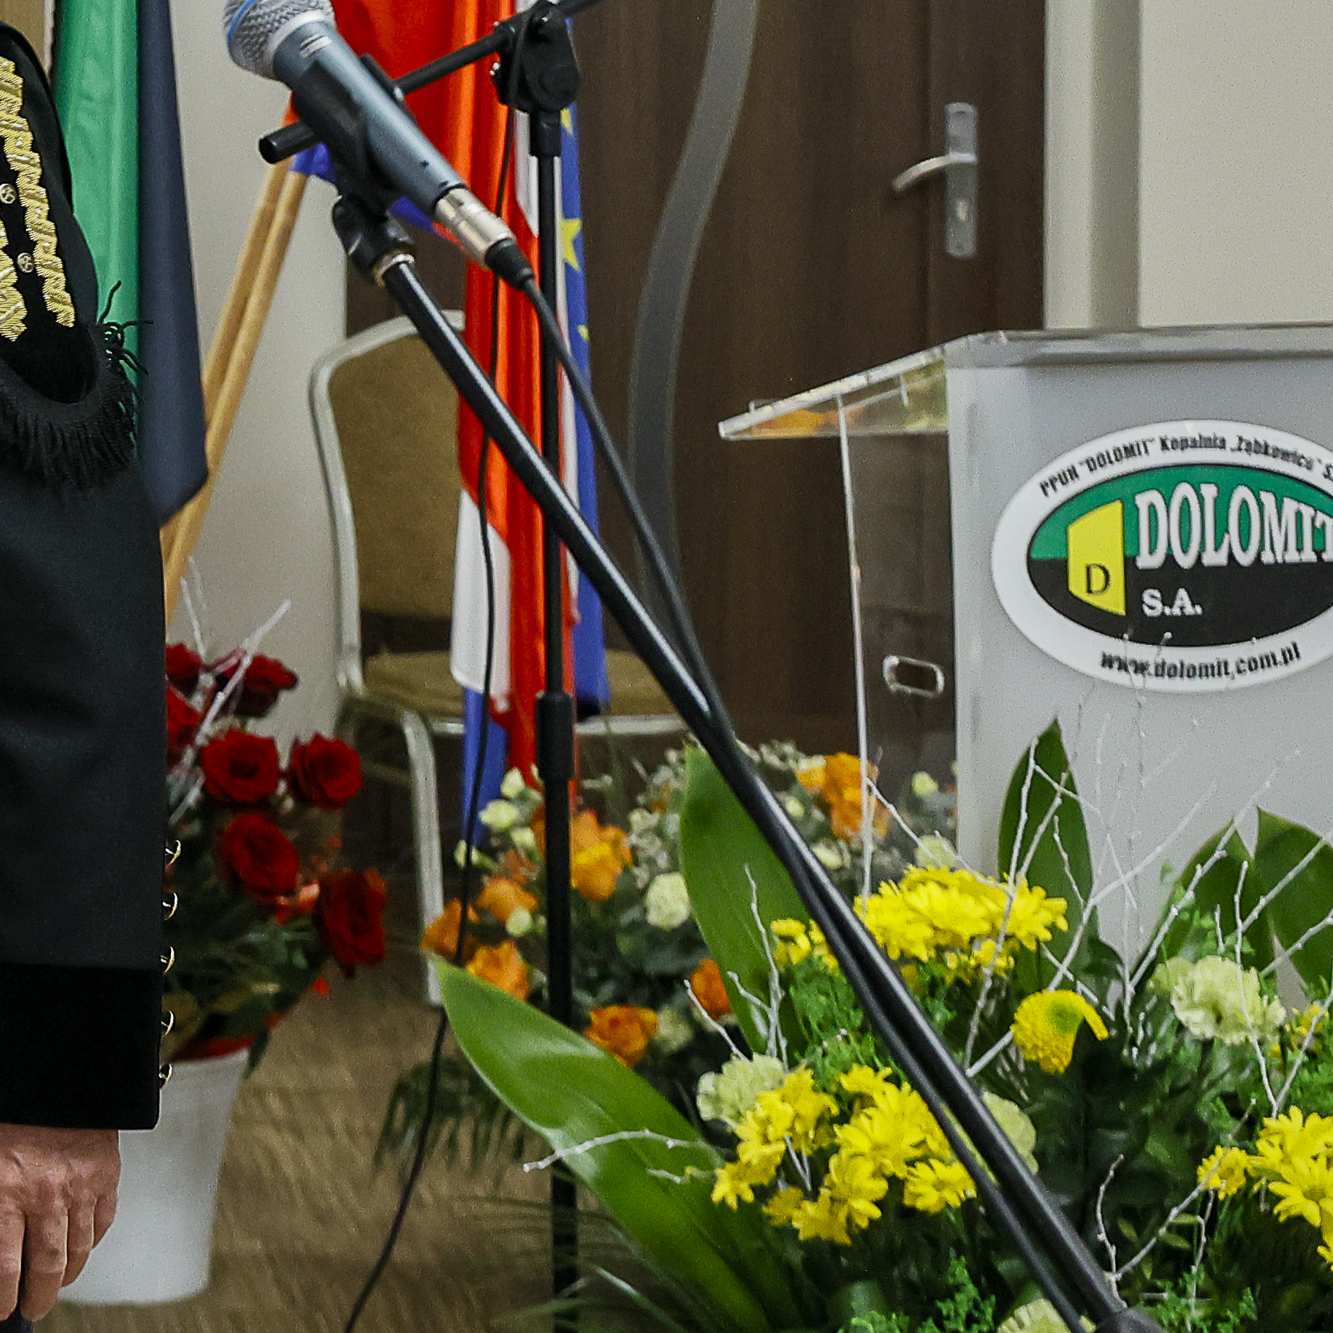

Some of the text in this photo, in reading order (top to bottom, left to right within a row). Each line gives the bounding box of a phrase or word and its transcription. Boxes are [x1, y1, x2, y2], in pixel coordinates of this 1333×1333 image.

[1134, 482, 1333, 569] DOLOMIT
[1085, 563, 1110, 595] D
[1141, 588, 1203, 617] S.A.
[1101, 641, 1301, 680] www.dolomit.com.pl
